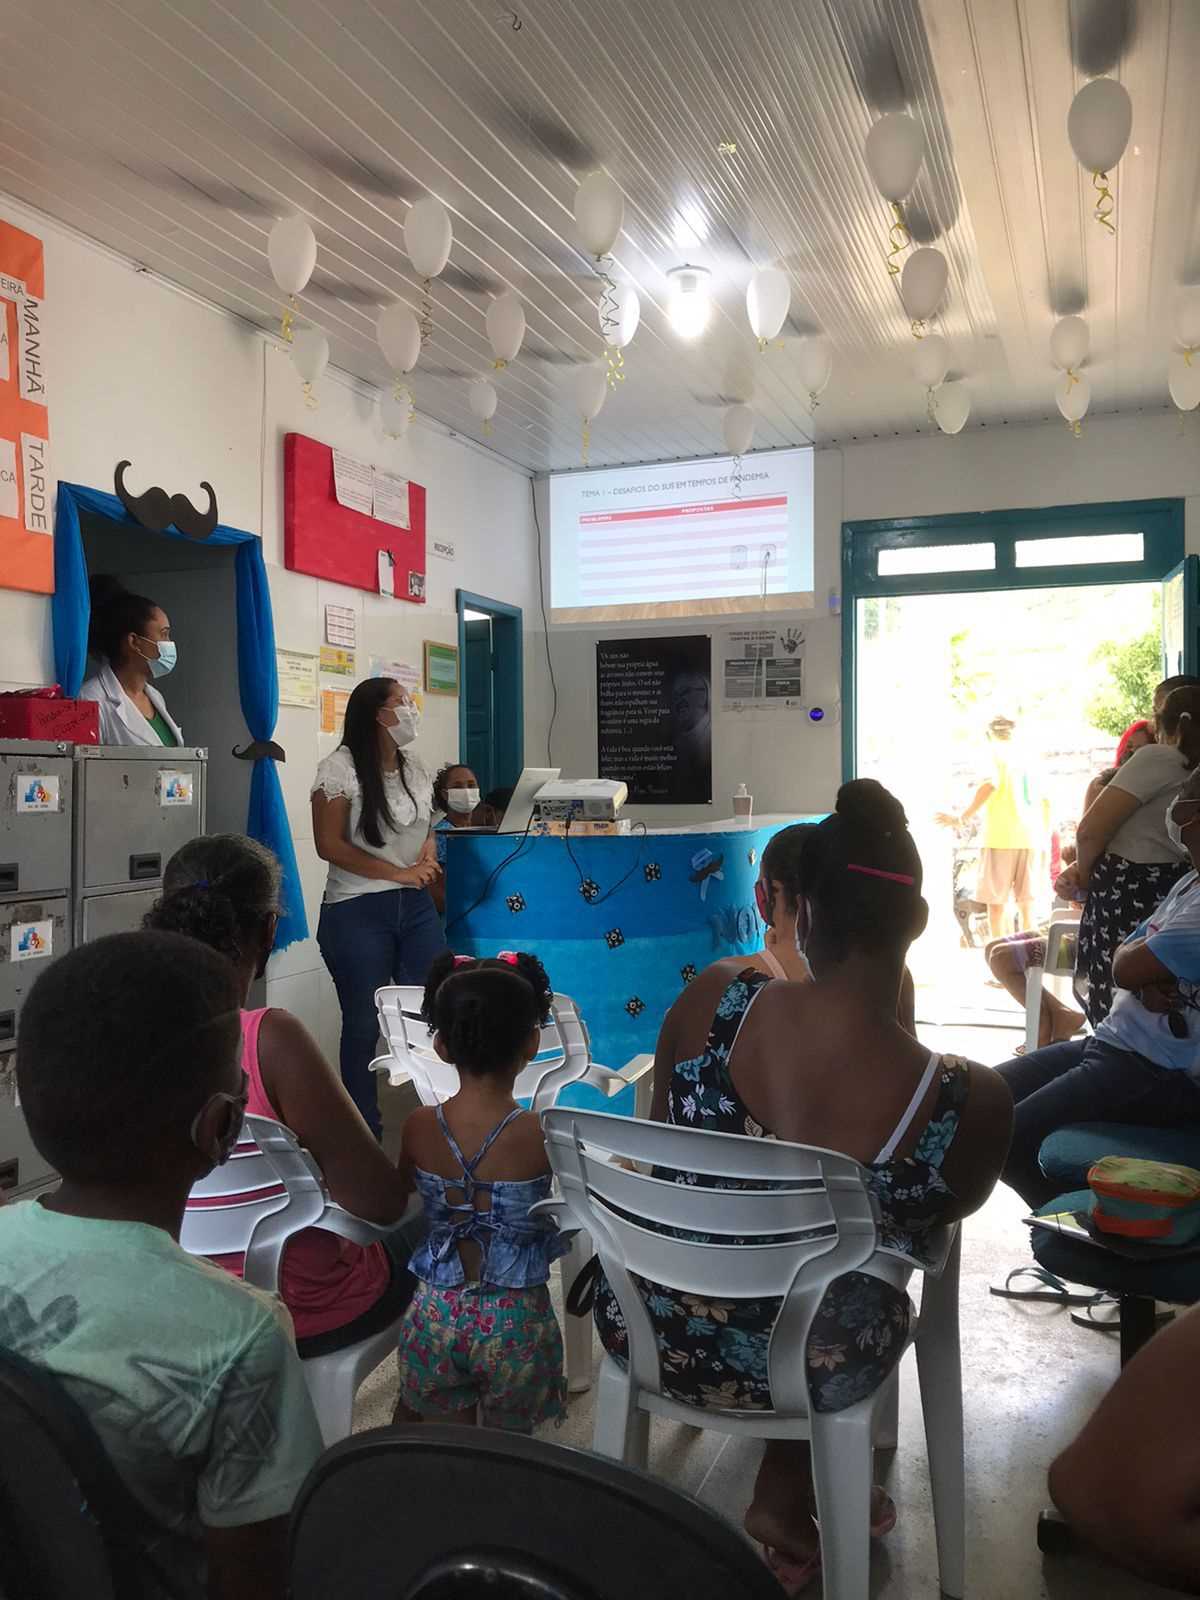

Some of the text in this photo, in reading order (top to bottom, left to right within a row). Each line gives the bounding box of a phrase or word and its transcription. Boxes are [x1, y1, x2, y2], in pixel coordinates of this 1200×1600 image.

[23, 298, 45, 394] MANHÃ
[29, 442, 47, 530] TARDE
[647, 483, 661, 493] DO
